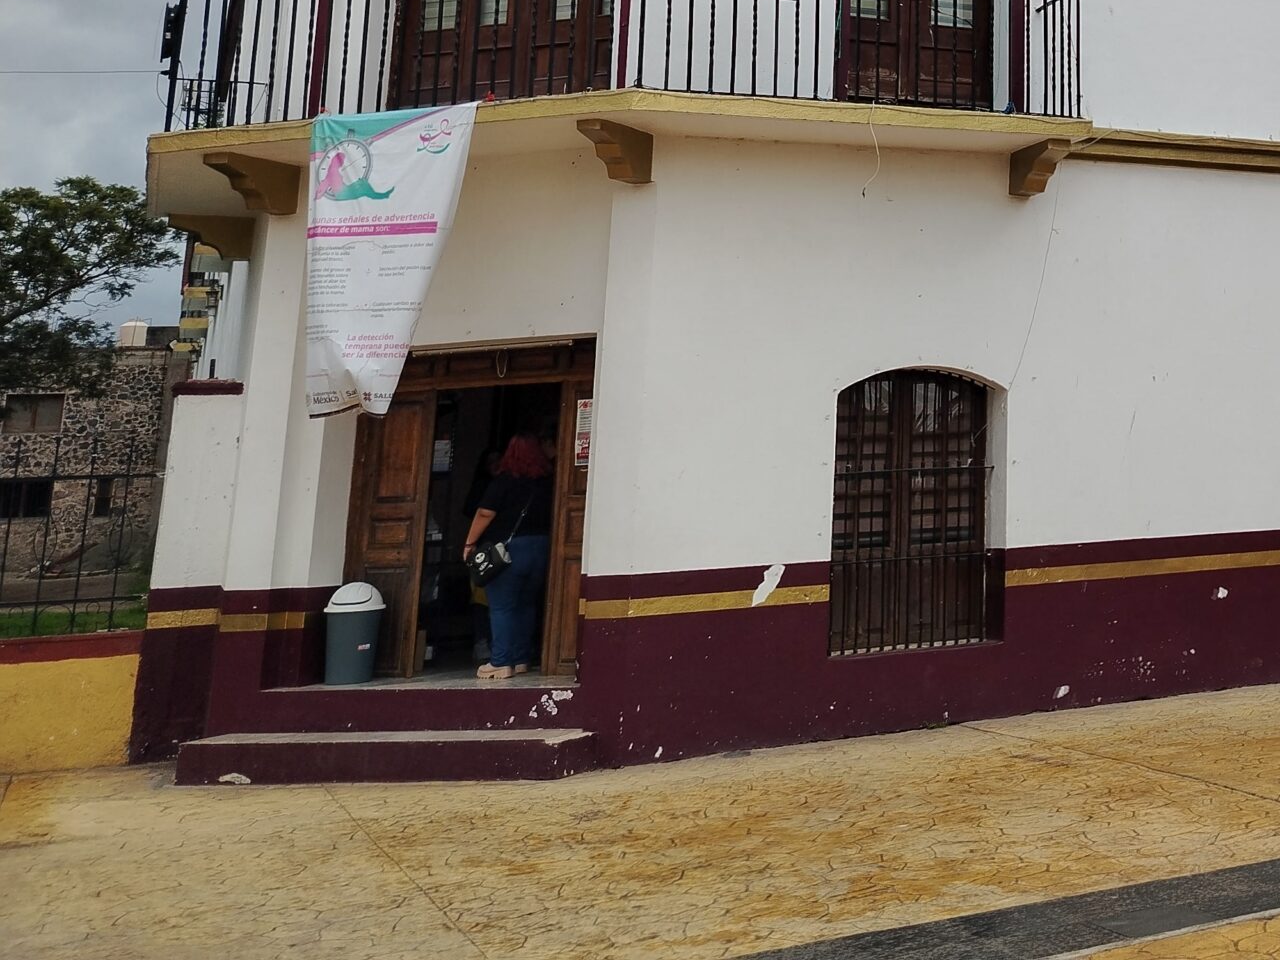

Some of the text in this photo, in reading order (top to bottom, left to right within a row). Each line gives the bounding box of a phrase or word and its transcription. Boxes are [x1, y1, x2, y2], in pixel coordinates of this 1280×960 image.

[339, 214, 370, 224] señales
[372, 214, 383, 223] de
[385, 211, 435, 222] advertencia
[340, 225, 349, 233] de
[351, 225, 374, 233] mama
[359, 332, 394, 341] detección
[344, 342, 410, 351] temprana puede
[312, 395, 340, 404] México
